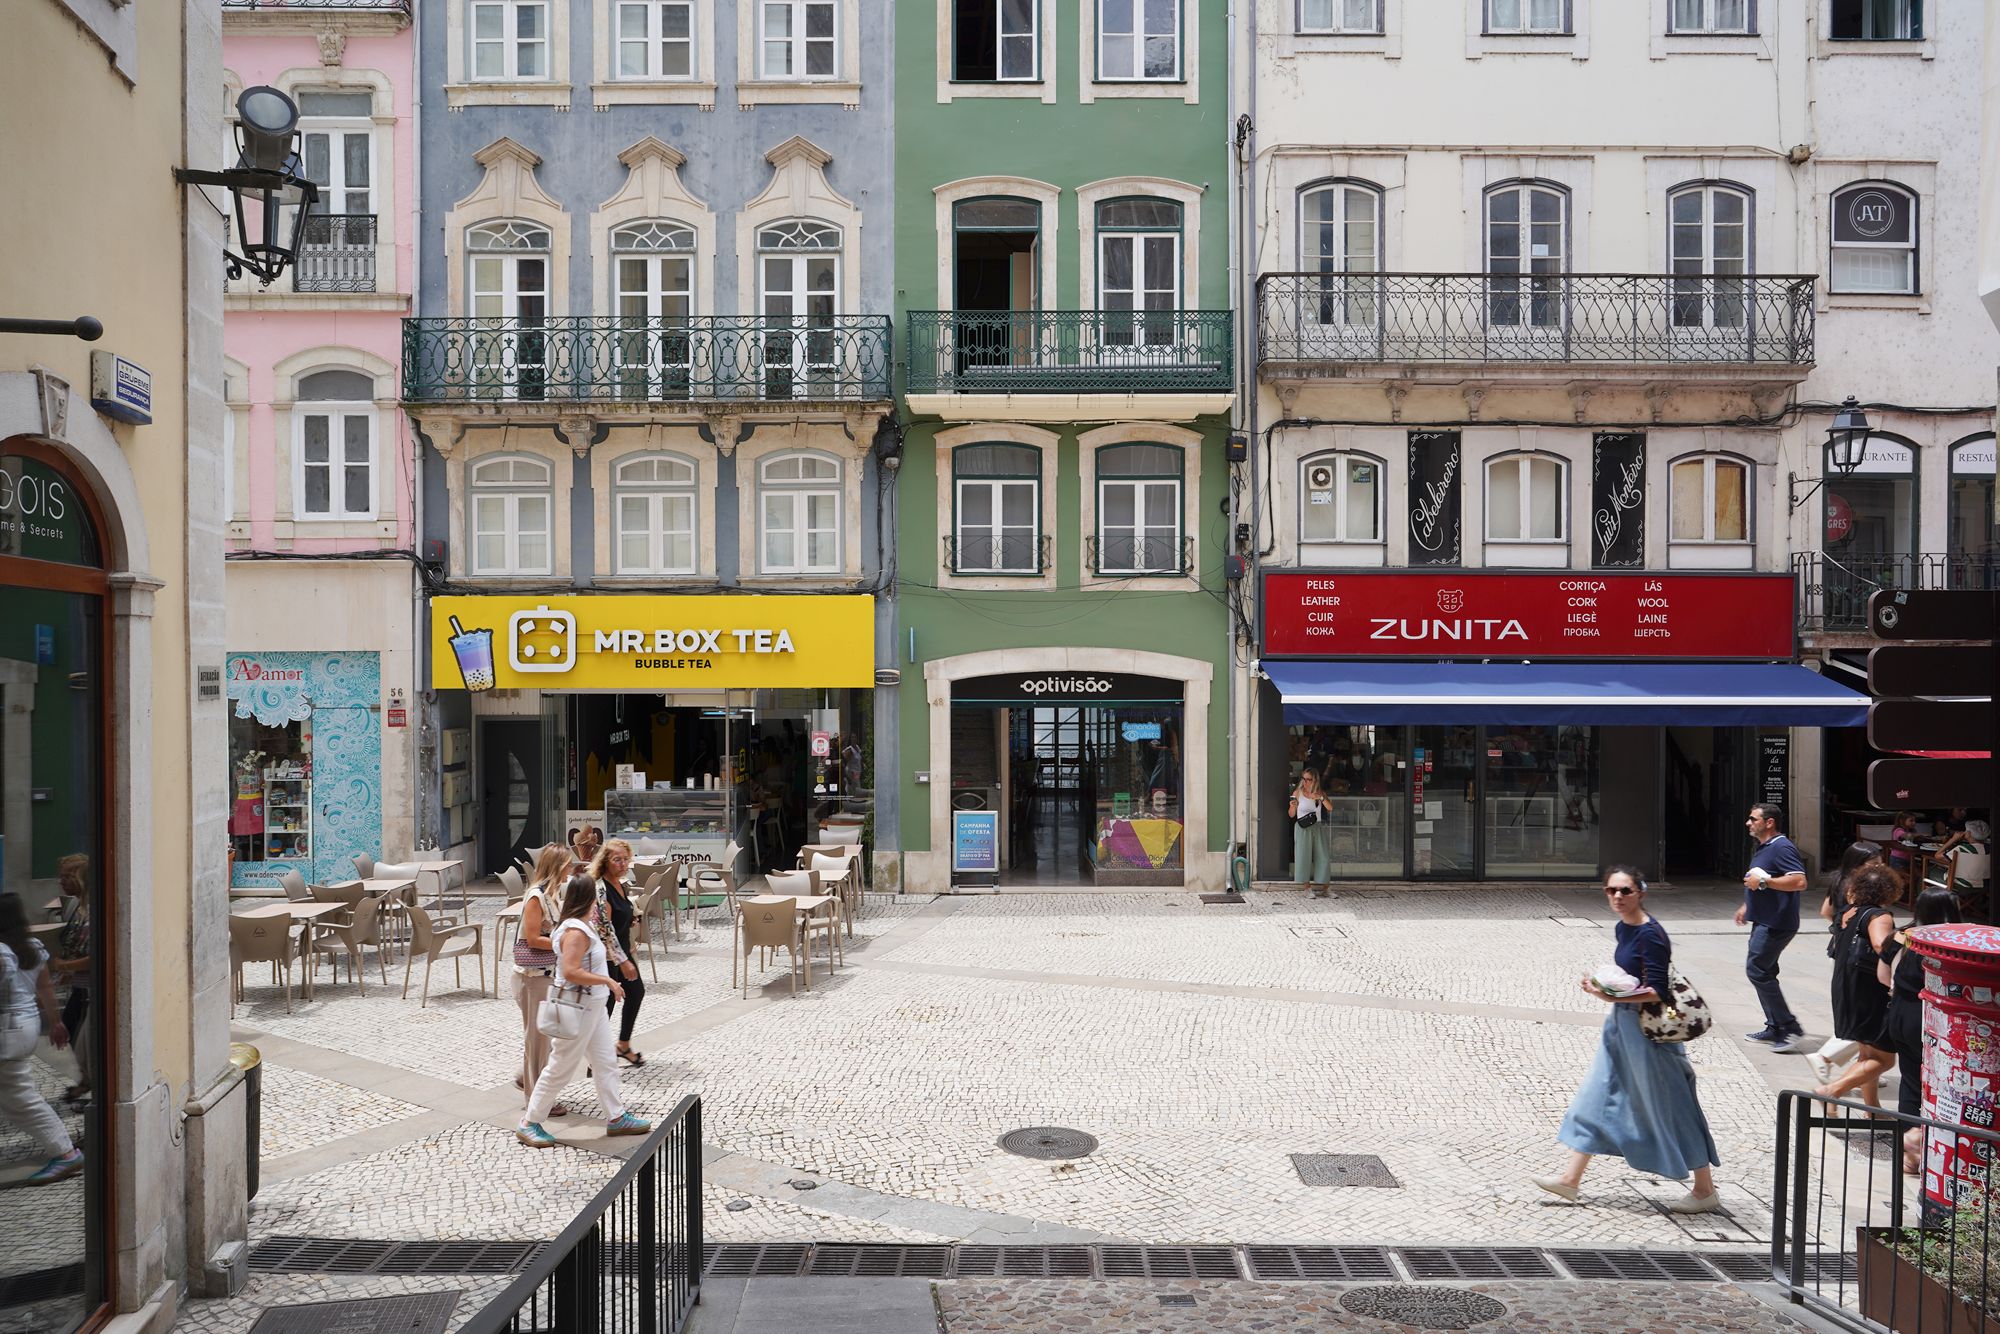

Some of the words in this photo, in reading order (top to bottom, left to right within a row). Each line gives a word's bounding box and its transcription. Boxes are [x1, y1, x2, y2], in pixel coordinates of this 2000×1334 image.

[1608, 444, 1643, 512] Monteiro
[1411, 442, 1459, 551] Cabeleireiro
[20, 521, 26, 533] &
[30, 523, 64, 539] Secrets
[1307, 581, 1335, 590] PELES
[1560, 581, 1606, 593] CORTIÇA
[1644, 580, 1662, 592] LÃS
[1301, 596, 1341, 606] LEATHER
[1567, 597, 1597, 607] CORK
[1638, 598, 1669, 608] WOOL
[1308, 612, 1334, 622] CUIR
[1567, 611, 1597, 623] LIEGÈ
[1638, 614, 1667, 623] LAINE
[1306, 627, 1335, 636] КОЖА
[1370, 619, 1528, 640] ZUNITA
[1563, 628, 1600, 637] ПРОБКА
[1634, 629, 1671, 637] ШЕРСТЬ
[594, 629, 722, 654] MR.BOX
[732, 629, 795, 653] TEA
[635, 659, 685, 669] BUBBLE
[688, 659, 712, 669] TEA
[1965, 1105, 1993, 1119] SEAS
[1964, 1112, 1993, 1126] CHET
